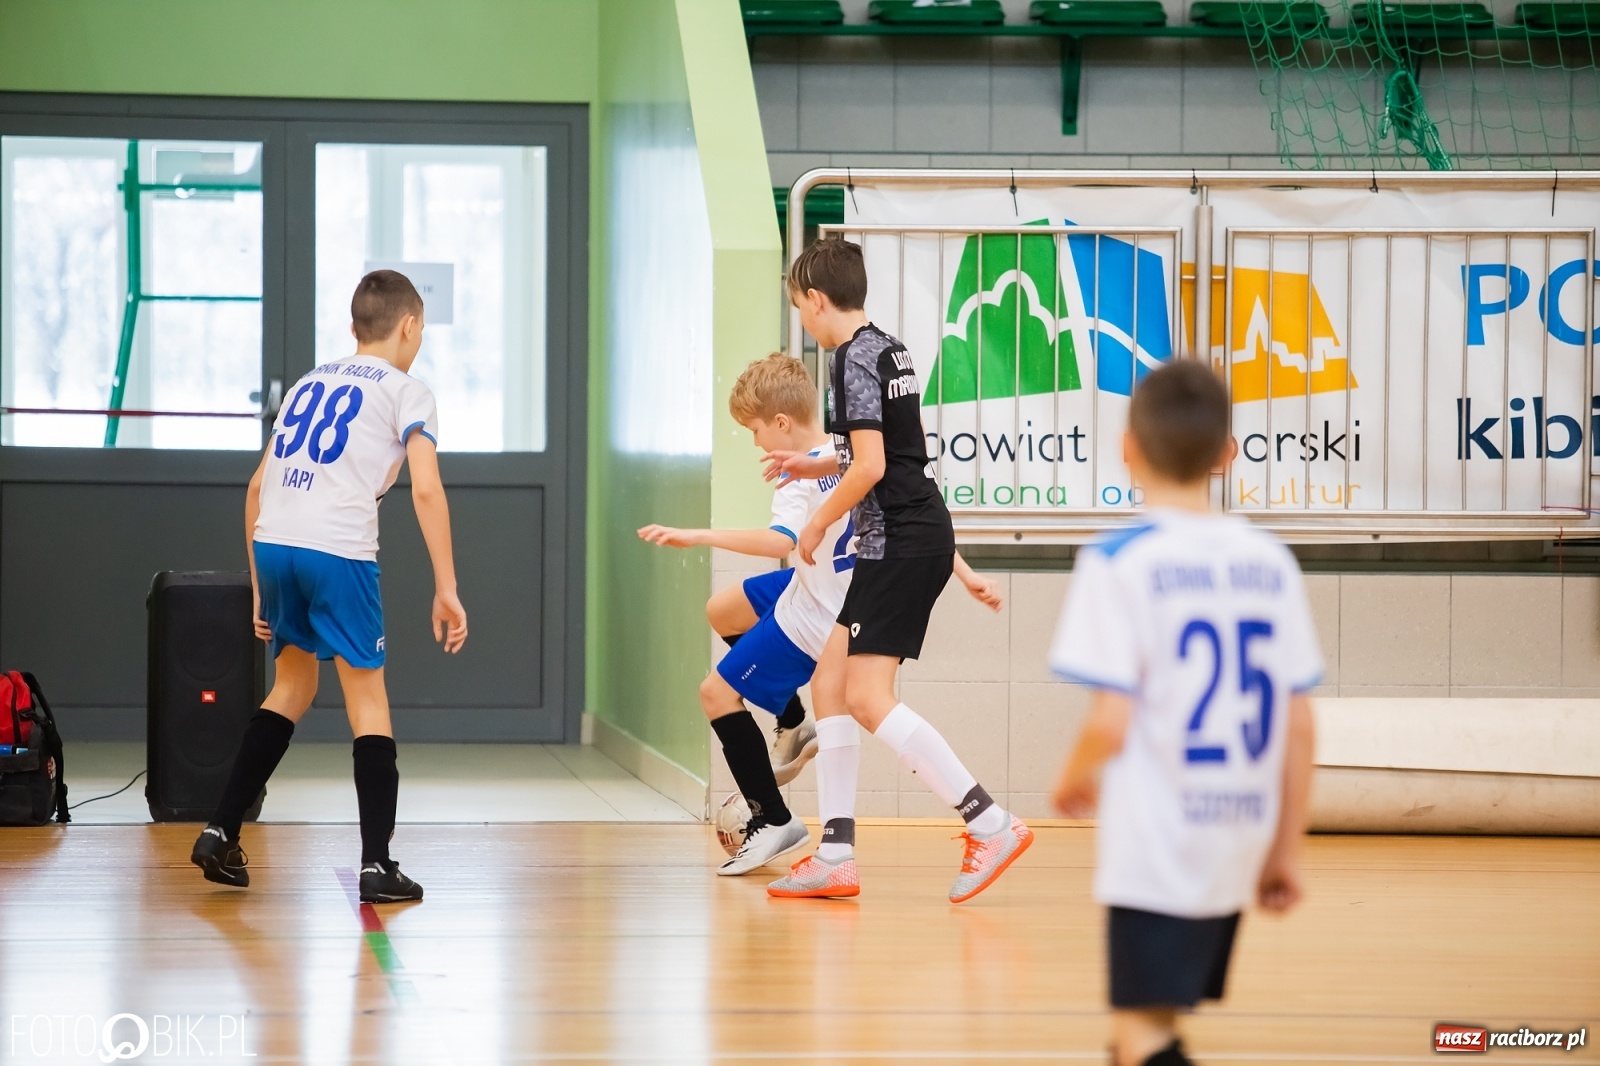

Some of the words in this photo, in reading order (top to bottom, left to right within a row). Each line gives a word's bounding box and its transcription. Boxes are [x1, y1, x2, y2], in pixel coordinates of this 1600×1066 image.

[341, 364, 388, 383] RADLIN
[274, 381, 363, 465] 98
[1243, 420, 1360, 462] orski
[282, 466, 315, 491] KAPI
[943, 477, 1067, 506] ielona
[1180, 619, 1274, 762] 25
